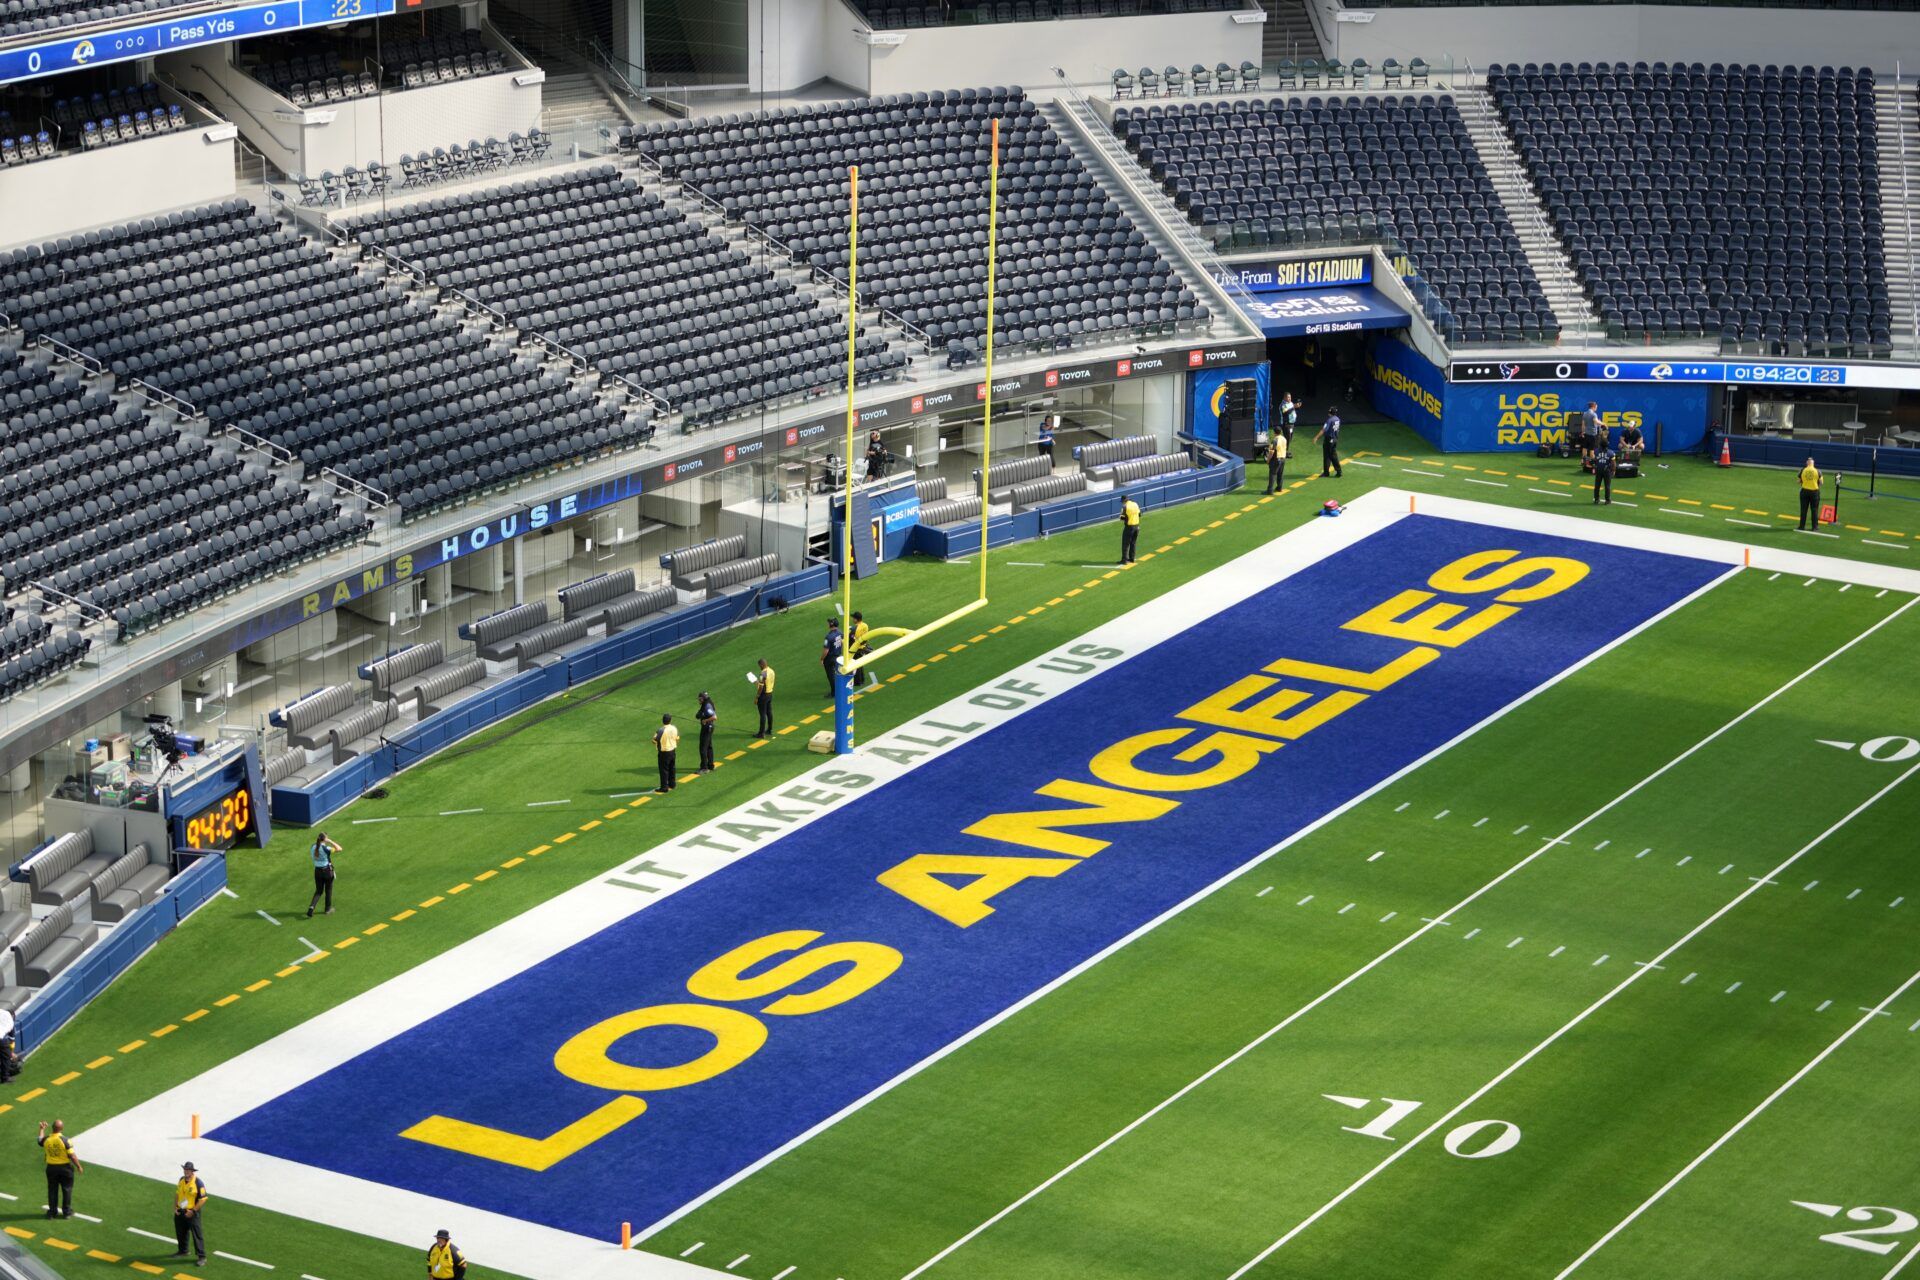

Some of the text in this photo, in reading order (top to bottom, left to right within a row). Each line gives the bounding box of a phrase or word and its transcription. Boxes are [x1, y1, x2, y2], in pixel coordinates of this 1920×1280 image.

[27, 52, 41, 73] 0
[169, 24, 204, 43] Pass
[209, 17, 235, 36] Yds
[263, 10, 276, 26] 0
[1213, 258, 1364, 287] Live From SOFI STADIUM
[1261, 303, 1371, 319] Stadium
[1306, 321, 1363, 335] SoFi Stadium
[1205, 350, 1237, 361] TOYOTA
[1132, 359, 1163, 371] TOYOTA
[1555, 363, 1572, 379] 0
[1603, 363, 1620, 379] 0
[1752, 366, 1811, 382] 94:20
[1060, 369, 1091, 380] TOYOTA
[992, 381, 1021, 393] TOYOTA
[925, 393, 953, 406] TOYOTA
[1499, 393, 1560, 410] LOS
[860, 408, 888, 421] TOYOTA
[1497, 411, 1644, 428] ANGES
[799, 424, 825, 438] TOYOTA
[1497, 429, 1571, 445] RAM
[737, 441, 763, 456] TOYOTA
[677, 459, 703, 474] TOYOTA
[889, 505, 920, 523] CBS NFL
[302, 493, 578, 620] RAMS HOUSE
[604, 643, 1125, 894] IT TAKES ALL OF US
[187, 789, 249, 849] 94:20
[400, 549, 1591, 1172] LOS ANGELES
